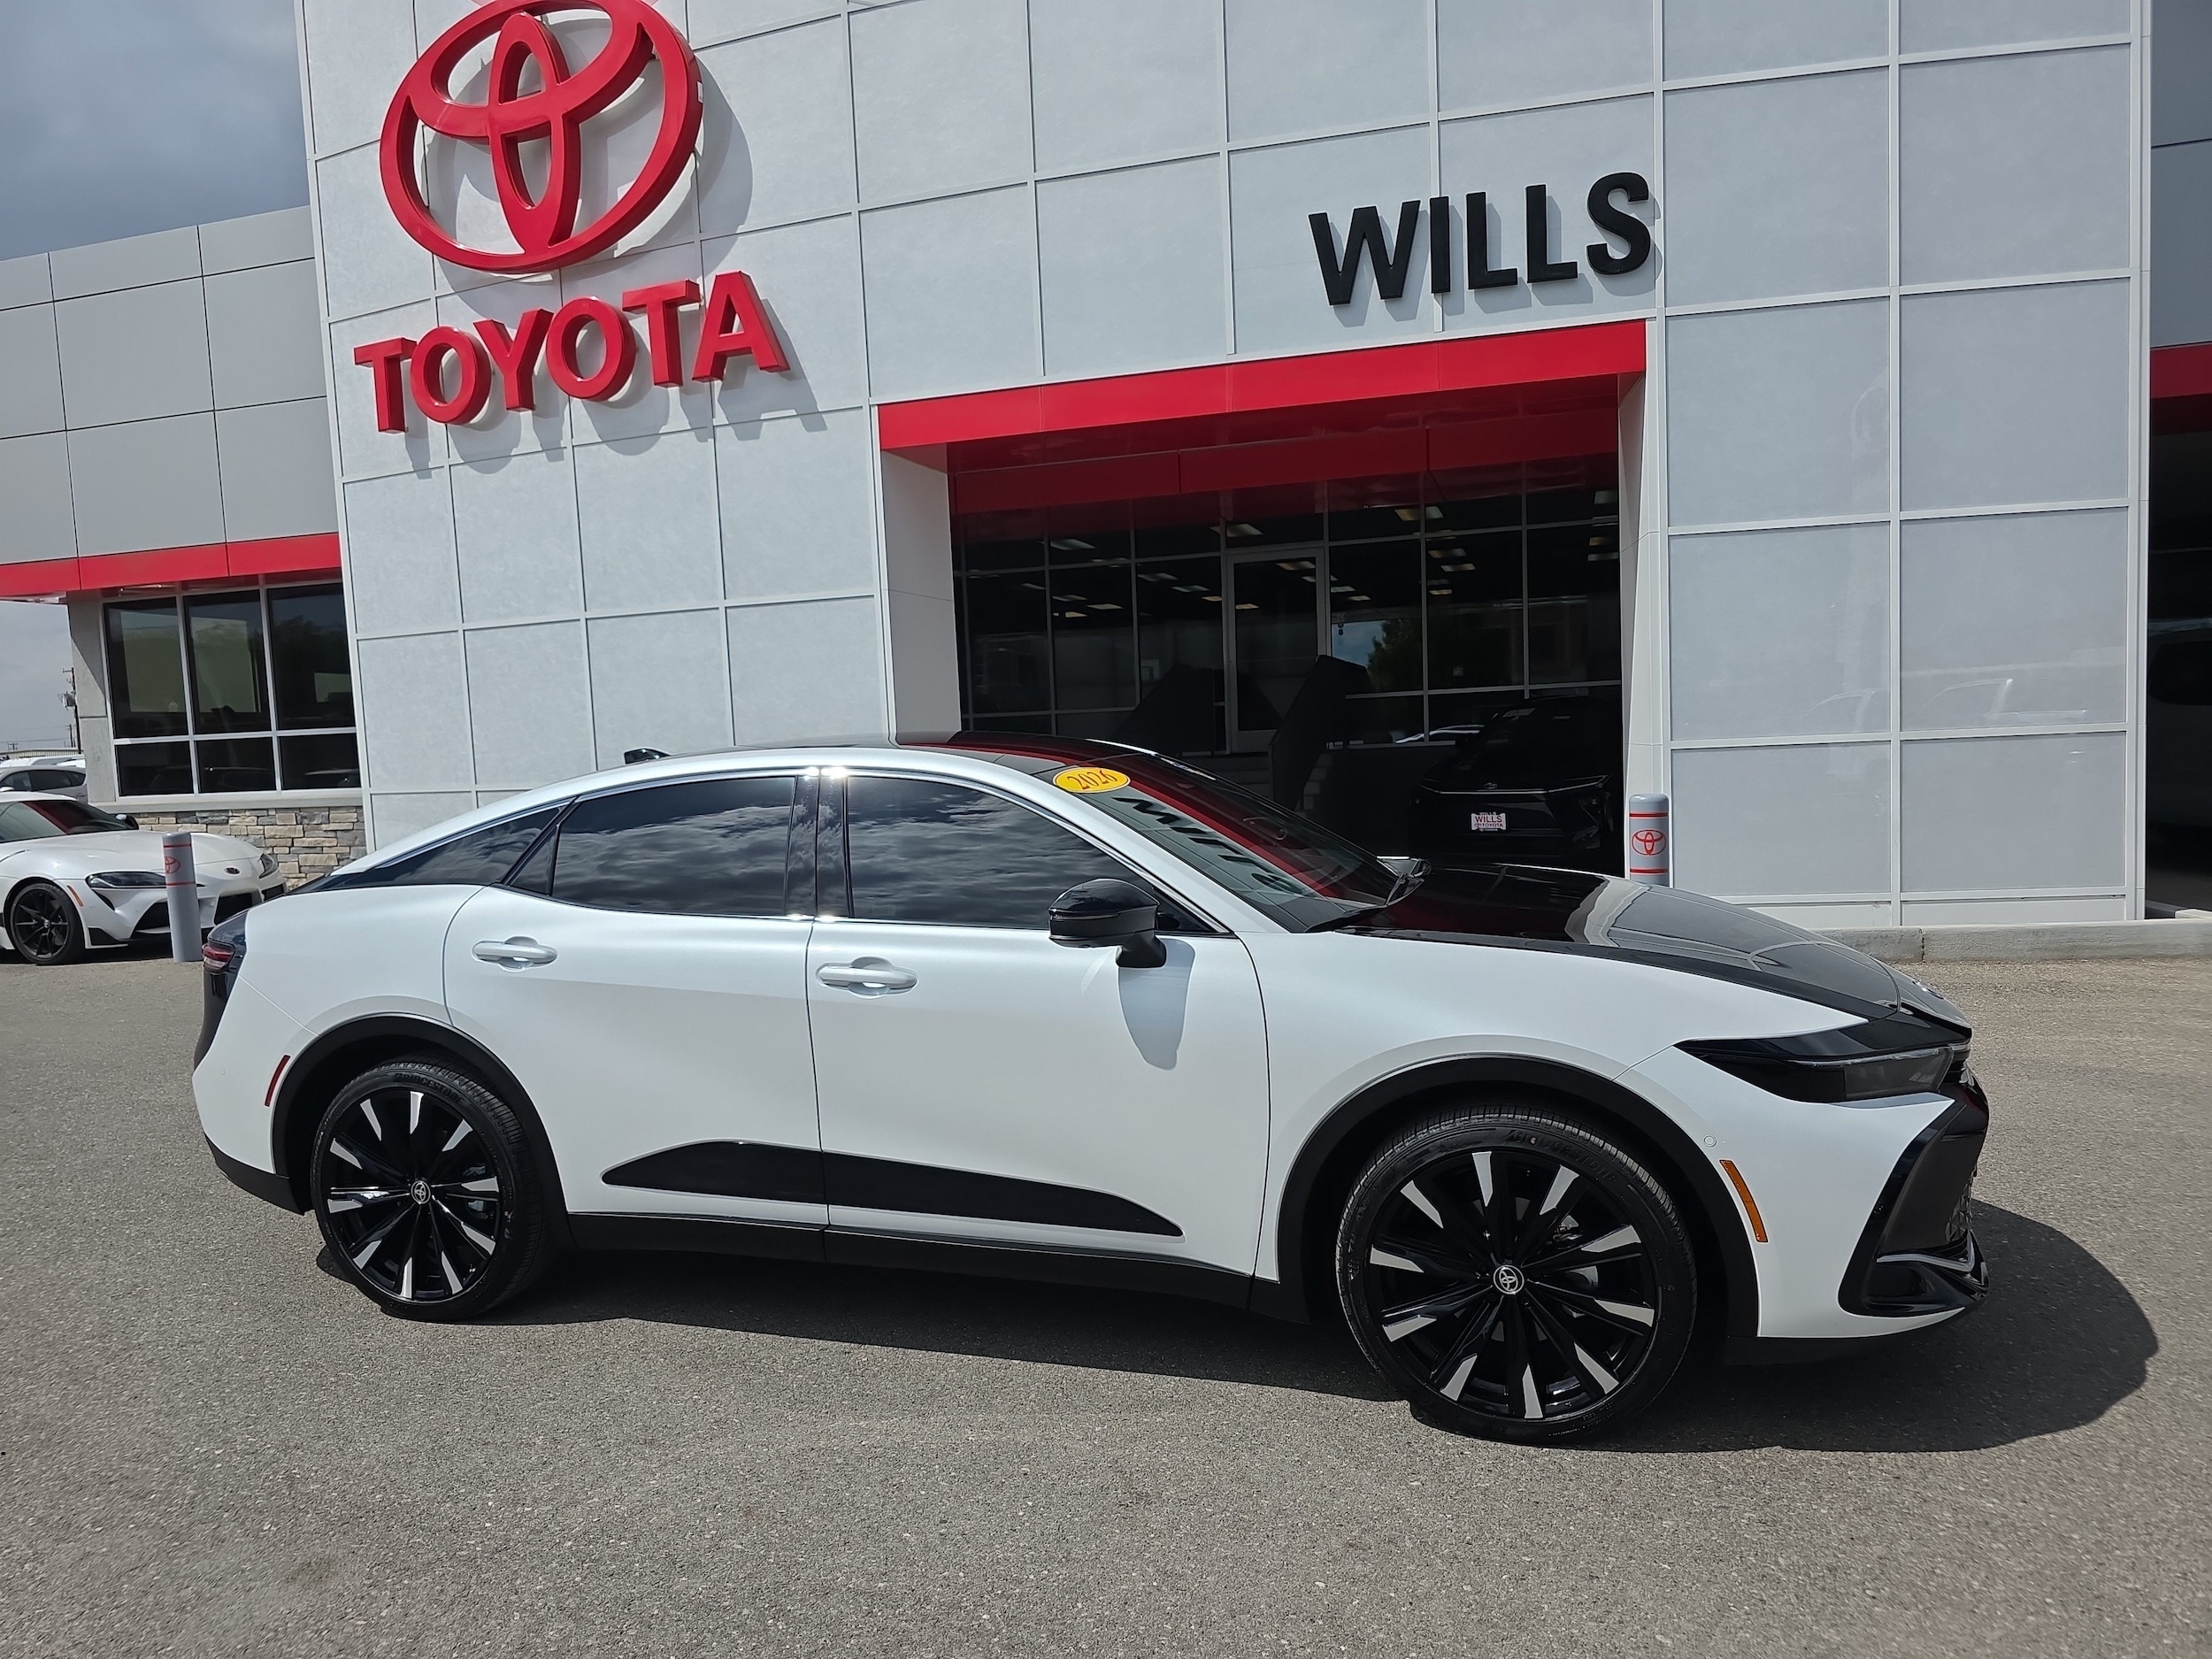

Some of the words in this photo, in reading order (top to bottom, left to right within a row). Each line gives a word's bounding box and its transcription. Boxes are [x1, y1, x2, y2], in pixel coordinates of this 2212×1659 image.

[1308, 172, 1651, 306] WILLS
[353, 271, 790, 433] TOYOTA
[1066, 769, 1118, 790] 2026
